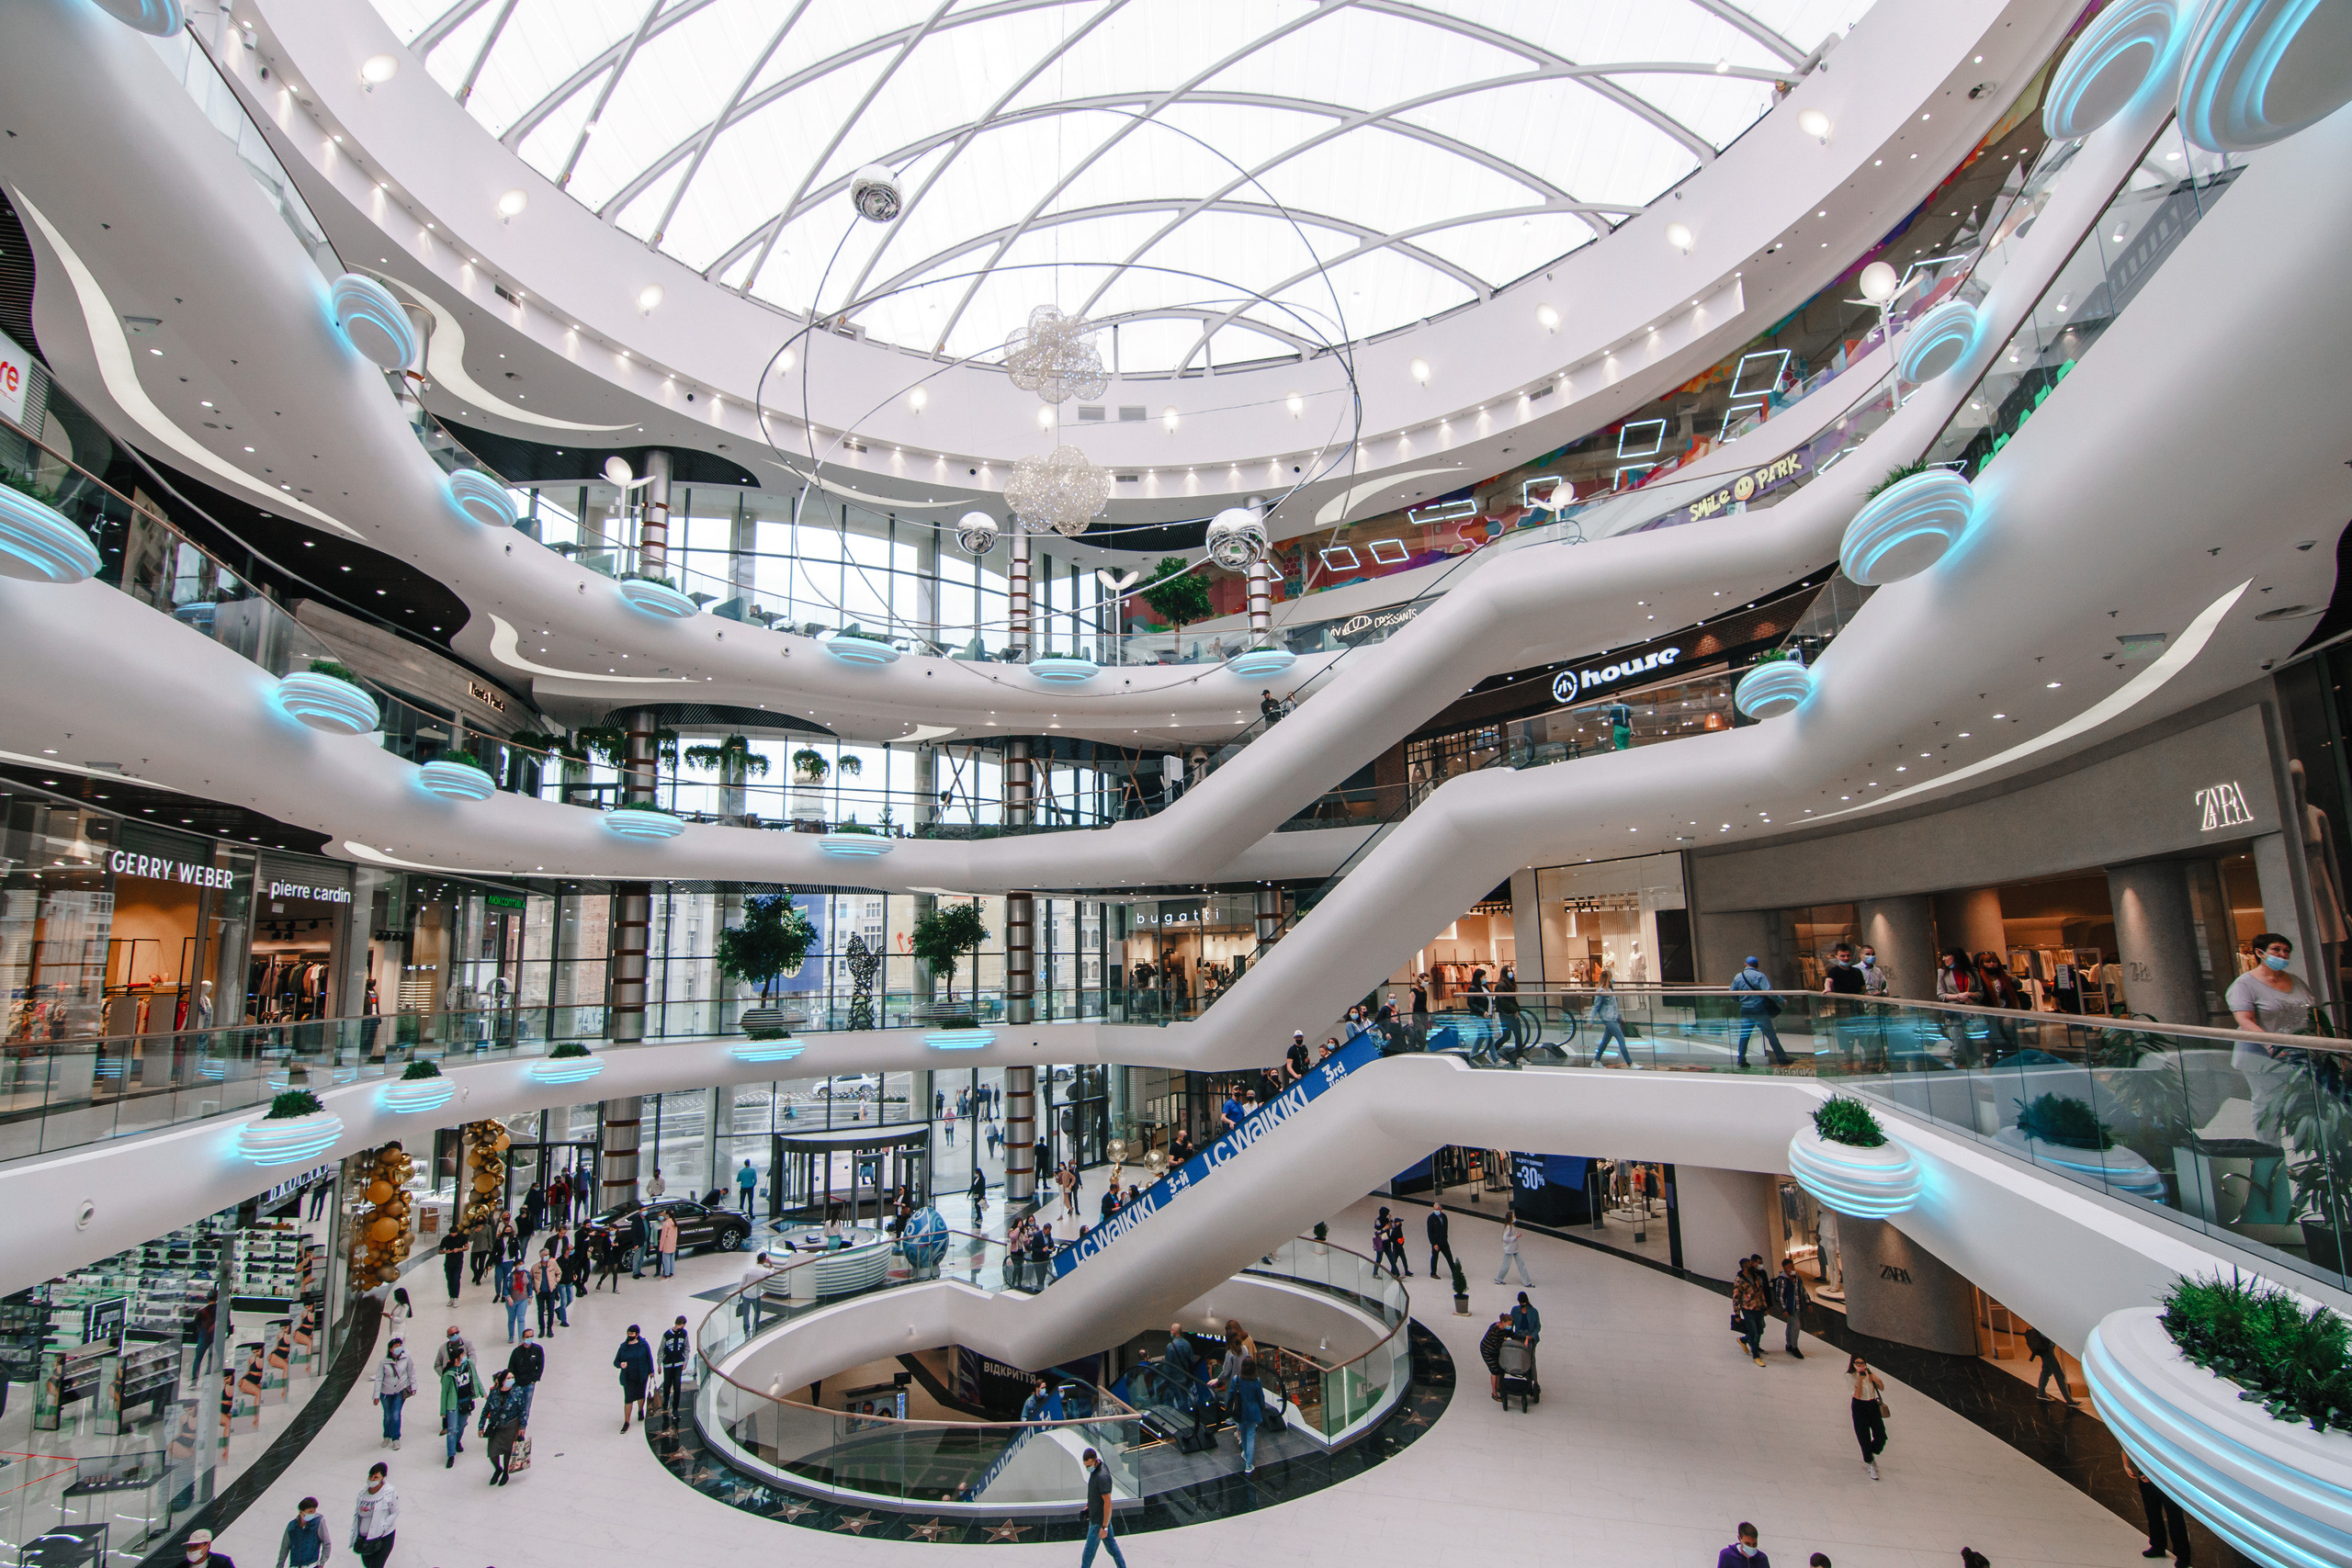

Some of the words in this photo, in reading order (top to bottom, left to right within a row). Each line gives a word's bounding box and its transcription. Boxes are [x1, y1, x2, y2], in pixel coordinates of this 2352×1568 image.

[1755, 453, 1802, 489] PARK
[1580, 648, 1680, 689] house
[2194, 781, 2254, 831] ZARA
[110, 850, 173, 880] GERRY
[178, 863, 233, 889] WEBER
[269, 879, 310, 899] pierre
[313, 886, 351, 903] cardin
[1136, 908, 1219, 925] bugatti
[1321, 1061, 1346, 1082] 3rd
[1203, 1142, 1231, 1174] LC
[1071, 1239, 1094, 1268] LC
[1880, 1263, 1912, 1284] ZARA
[984, 1361, 1036, 1384] ВІДКРИТТЯ
